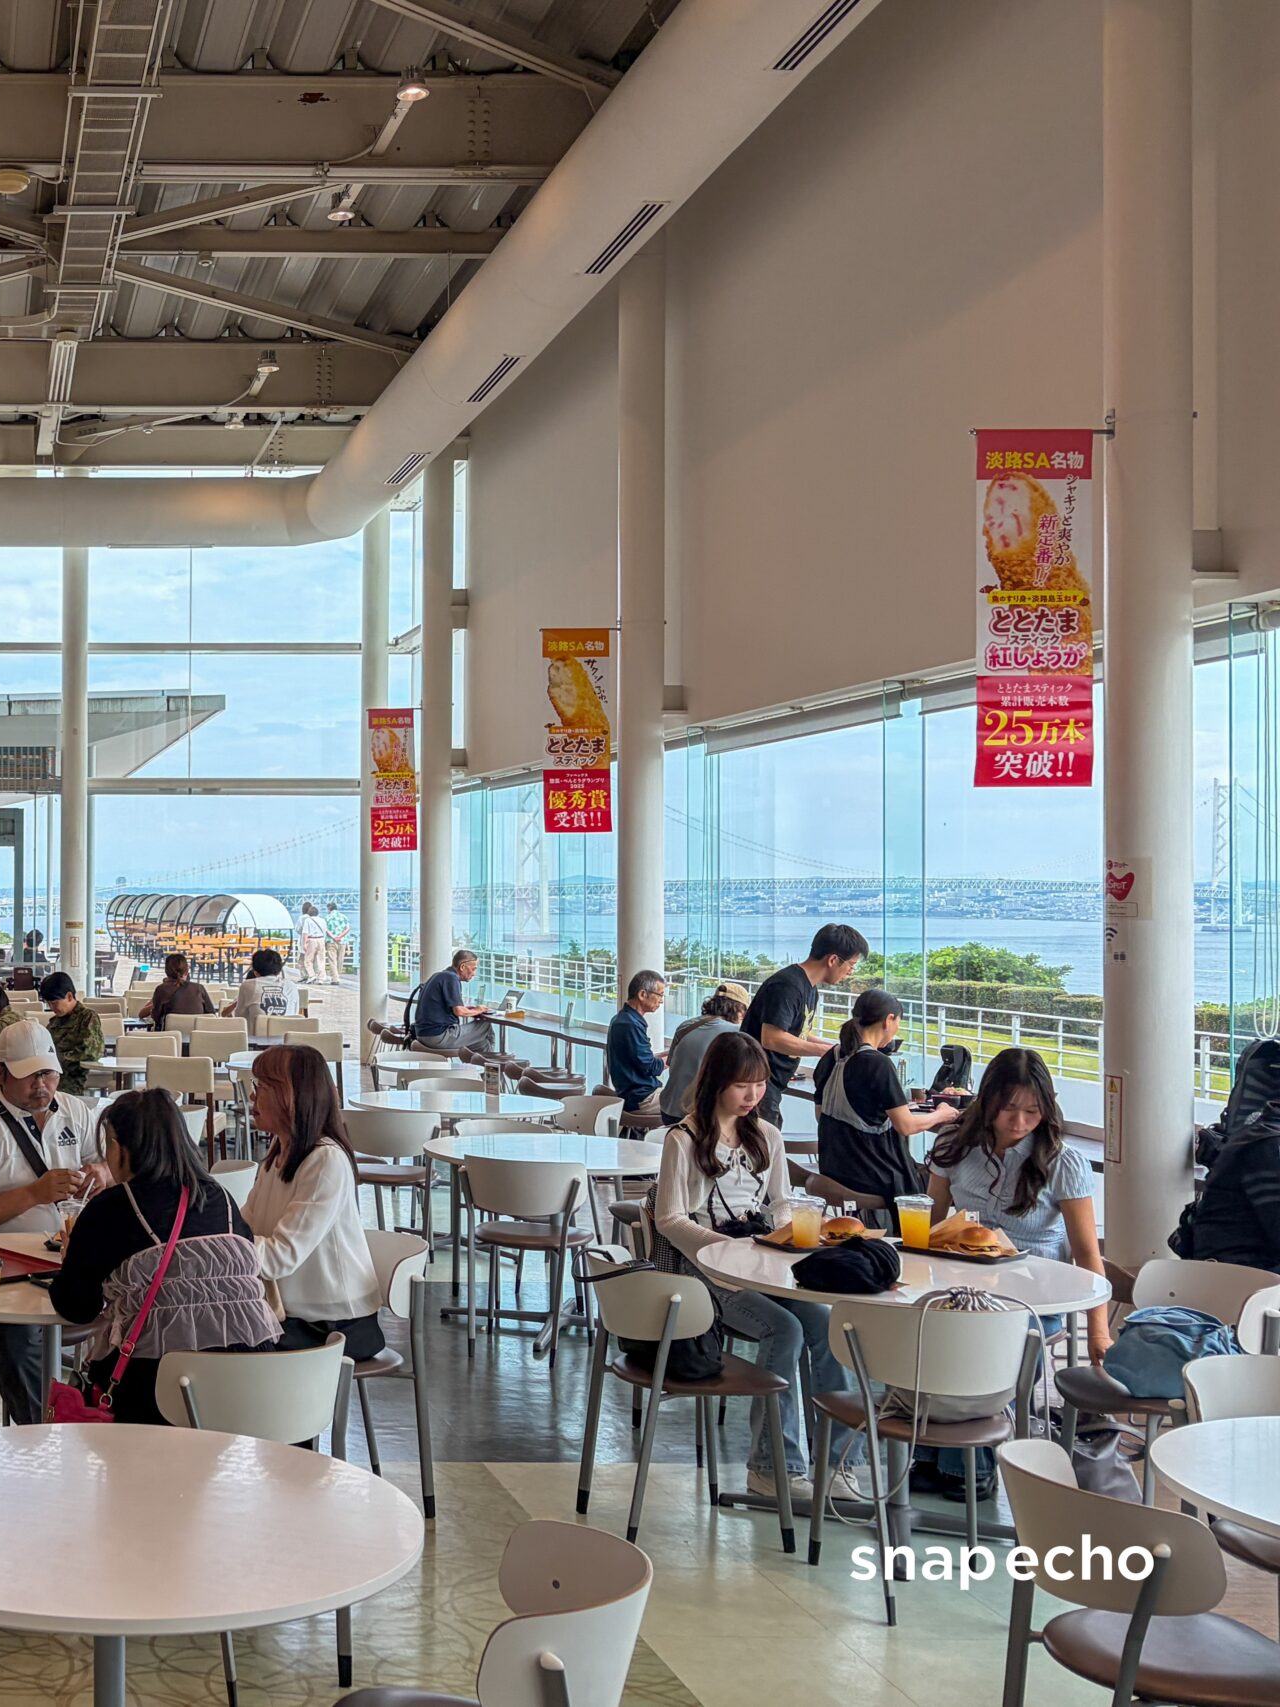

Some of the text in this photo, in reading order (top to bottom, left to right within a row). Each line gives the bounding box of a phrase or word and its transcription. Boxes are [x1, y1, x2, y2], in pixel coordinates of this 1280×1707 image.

[985, 451, 1084, 469] 淡路SA名物
[991, 608, 1078, 634] ととたま
[987, 643, 1087, 668] 紅しょうが
[983, 709, 1086, 746] 25万本
[547, 737, 605, 753] ととたま
[993, 751, 1075, 779] 突破!!
[548, 789, 608, 810] 優秀賞
[373, 820, 414, 835] 25万本
[553, 811, 602, 828] 受賞!!
